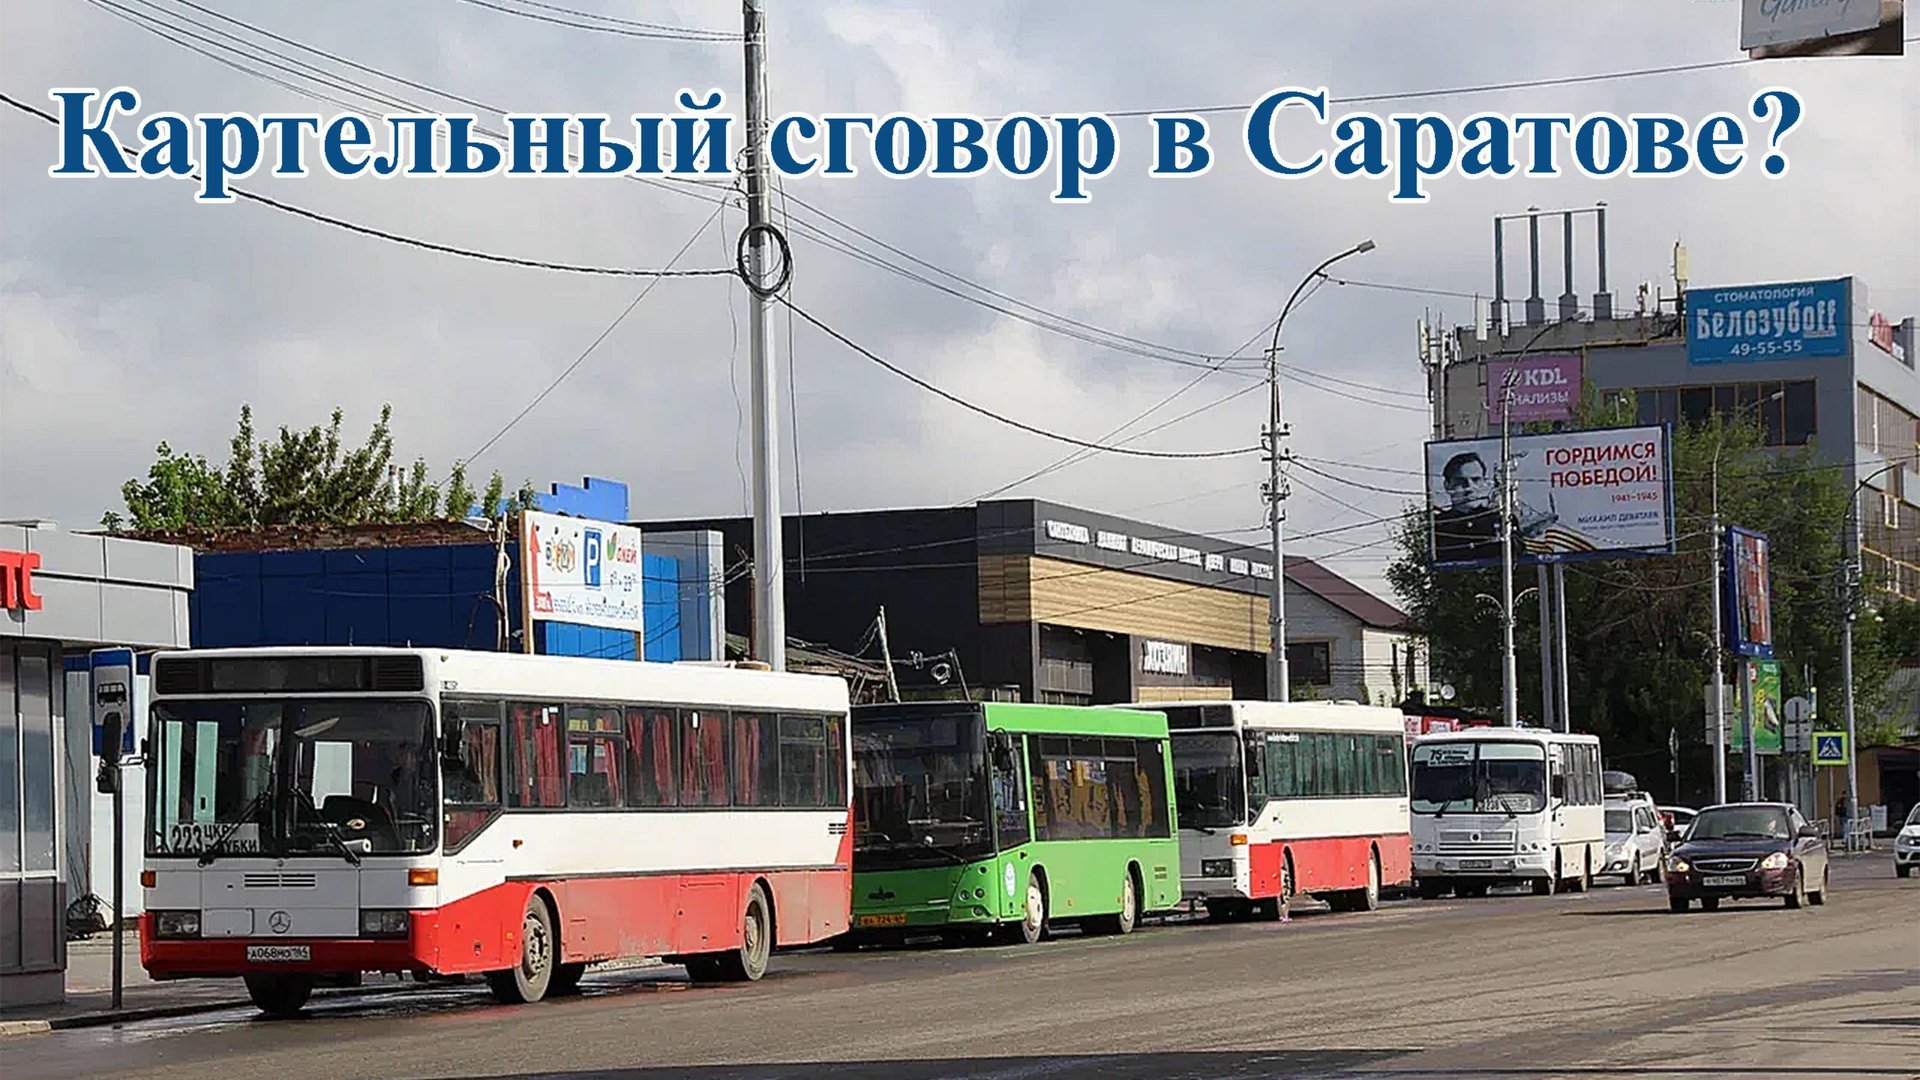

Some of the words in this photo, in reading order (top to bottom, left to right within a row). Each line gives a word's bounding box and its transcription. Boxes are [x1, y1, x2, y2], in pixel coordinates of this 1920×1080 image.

[1714, 287, 1814, 303] СТОМАТОЛОГИЯ
[1730, 340, 1802, 356] 49-55-55
[1524, 367, 1567, 386] KDL
[1508, 391, 1569, 406] НАЛИЗЫ
[1545, 442, 1656, 467] ГОРДИМСЯ
[1550, 462, 1658, 488] ПОБЕДОЙ!
[1430, 749, 1443, 760] 75
[172, 825, 203, 854] 223
